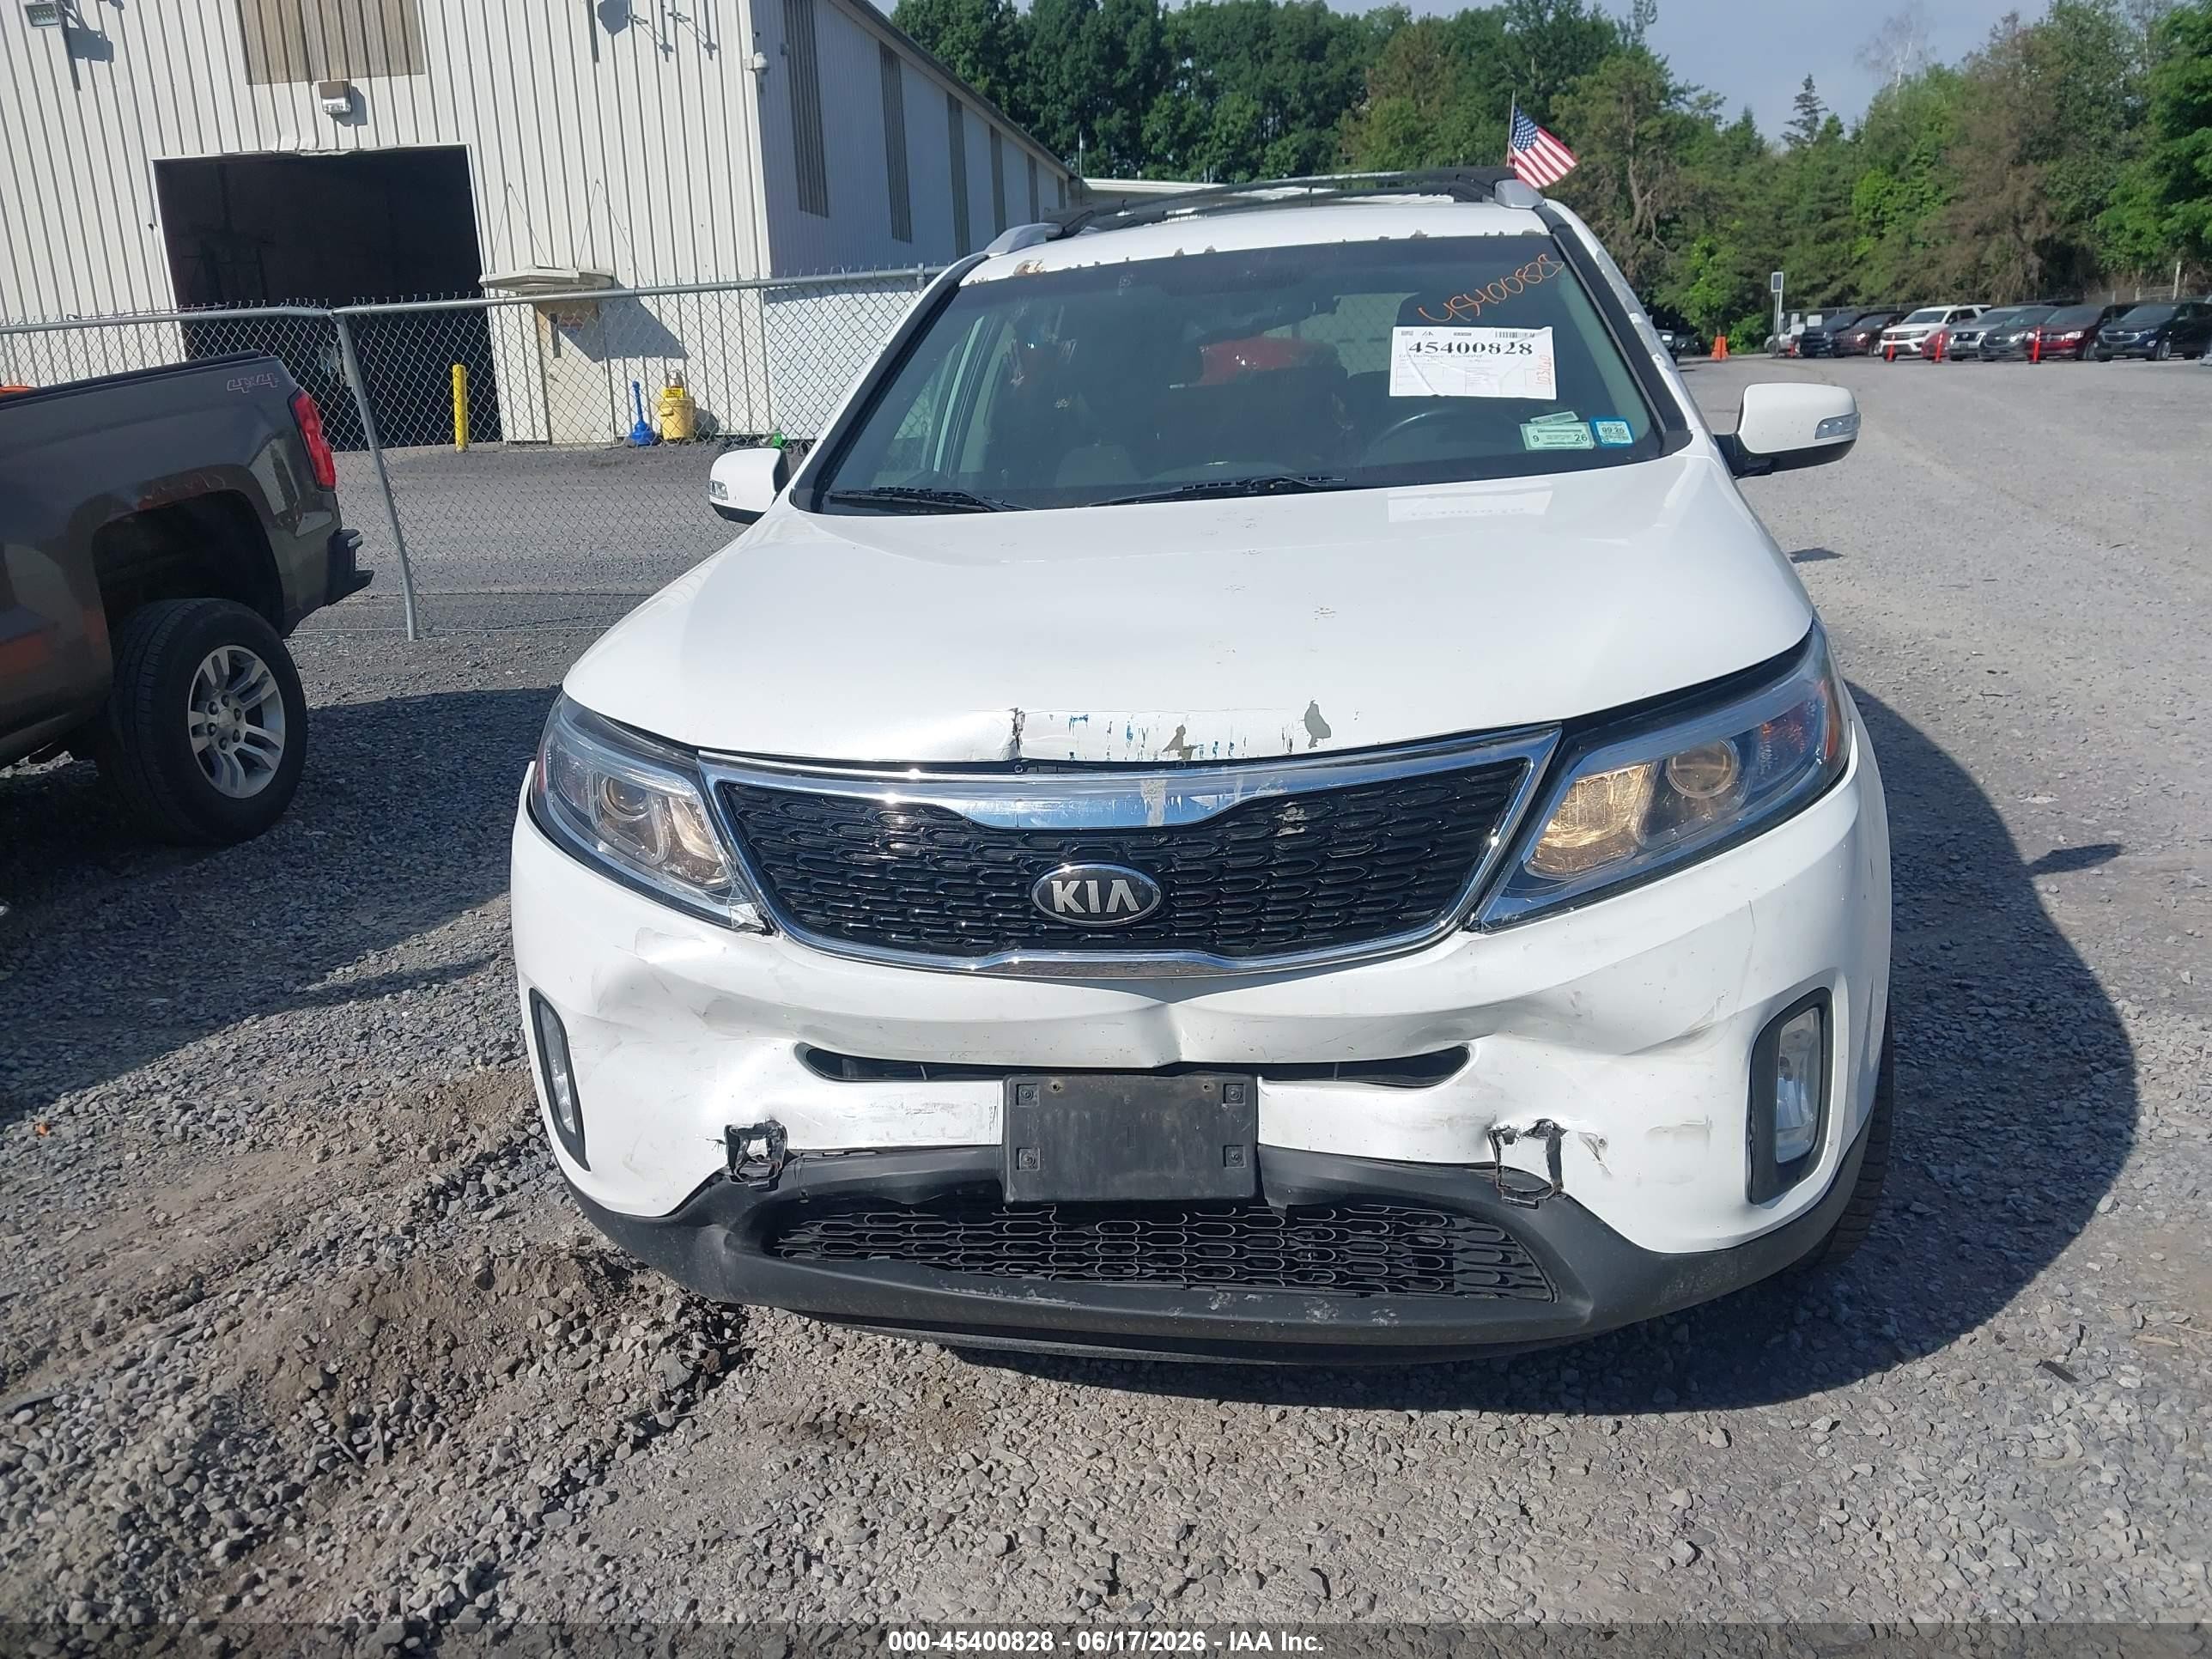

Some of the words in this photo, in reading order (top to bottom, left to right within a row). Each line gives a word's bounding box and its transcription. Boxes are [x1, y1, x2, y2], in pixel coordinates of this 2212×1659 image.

[1408, 341, 1533, 355] 45400828
[1573, 433, 1588, 442] 26
[1050, 879, 1140, 914] KIA
